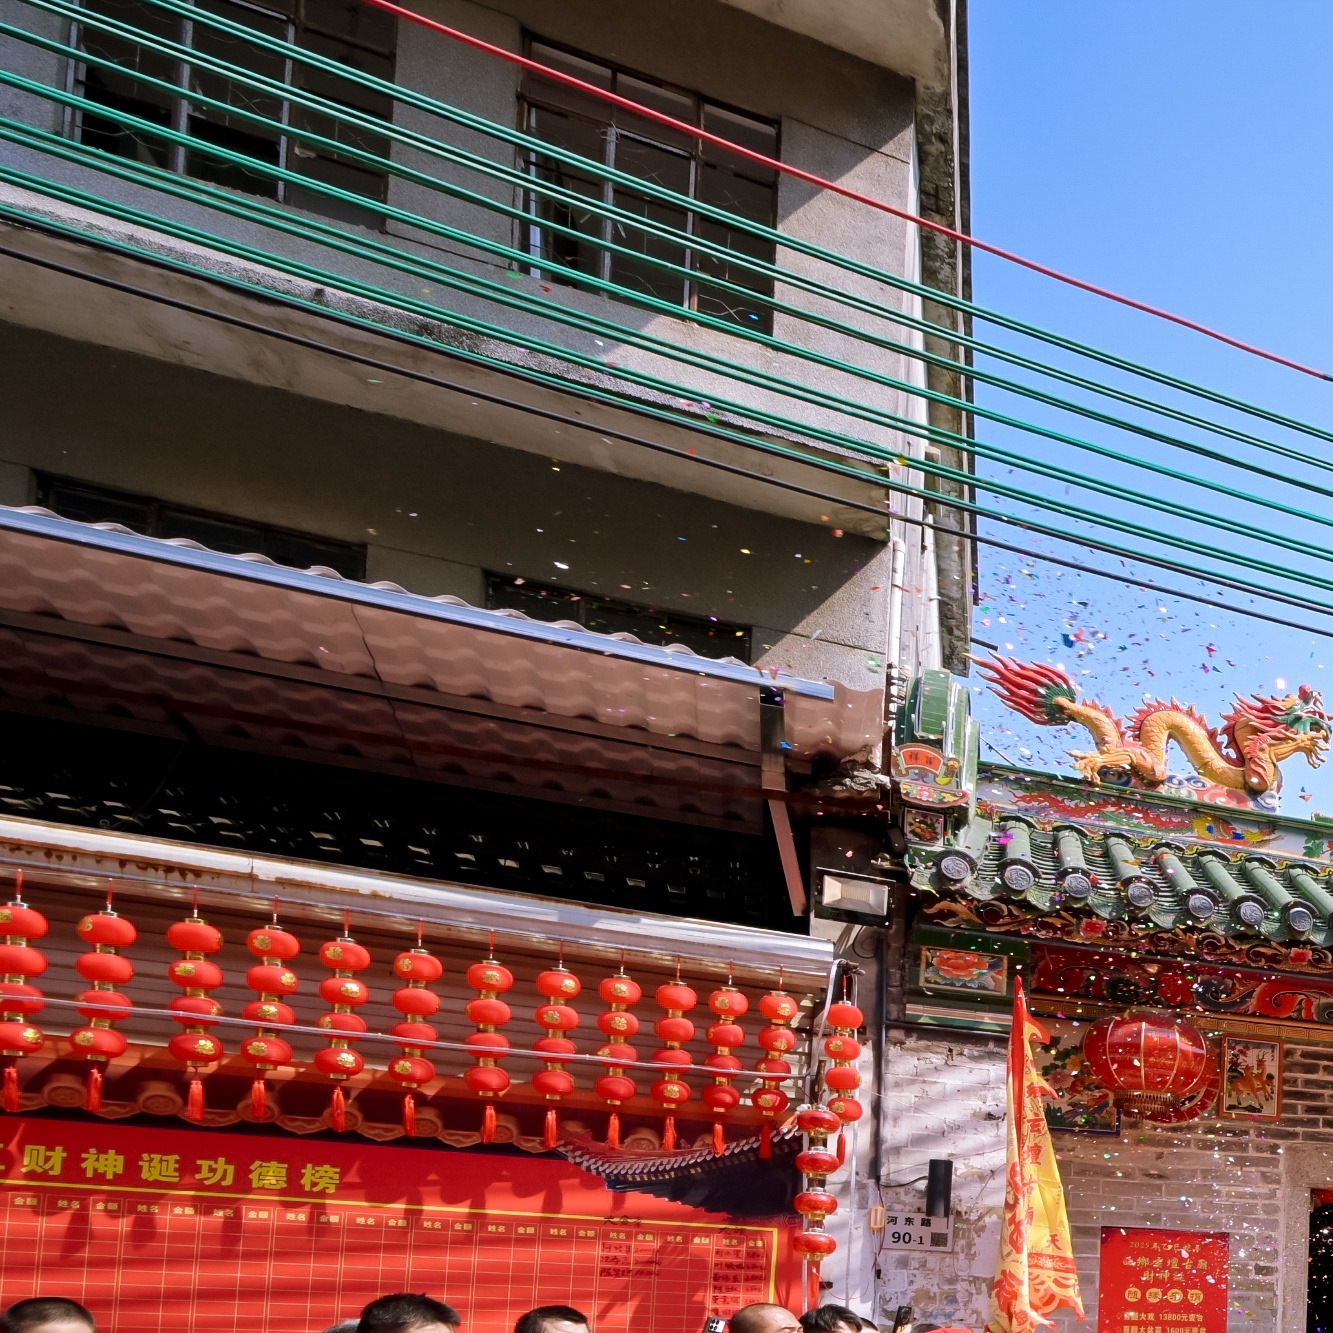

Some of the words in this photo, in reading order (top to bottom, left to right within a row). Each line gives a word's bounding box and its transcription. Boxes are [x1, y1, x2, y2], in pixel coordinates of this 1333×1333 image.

[0, 1144, 340, 1194] 财神诞功德榜
[886, 1215, 932, 1227] 河东路
[891, 1231, 924, 1245] 90-1
